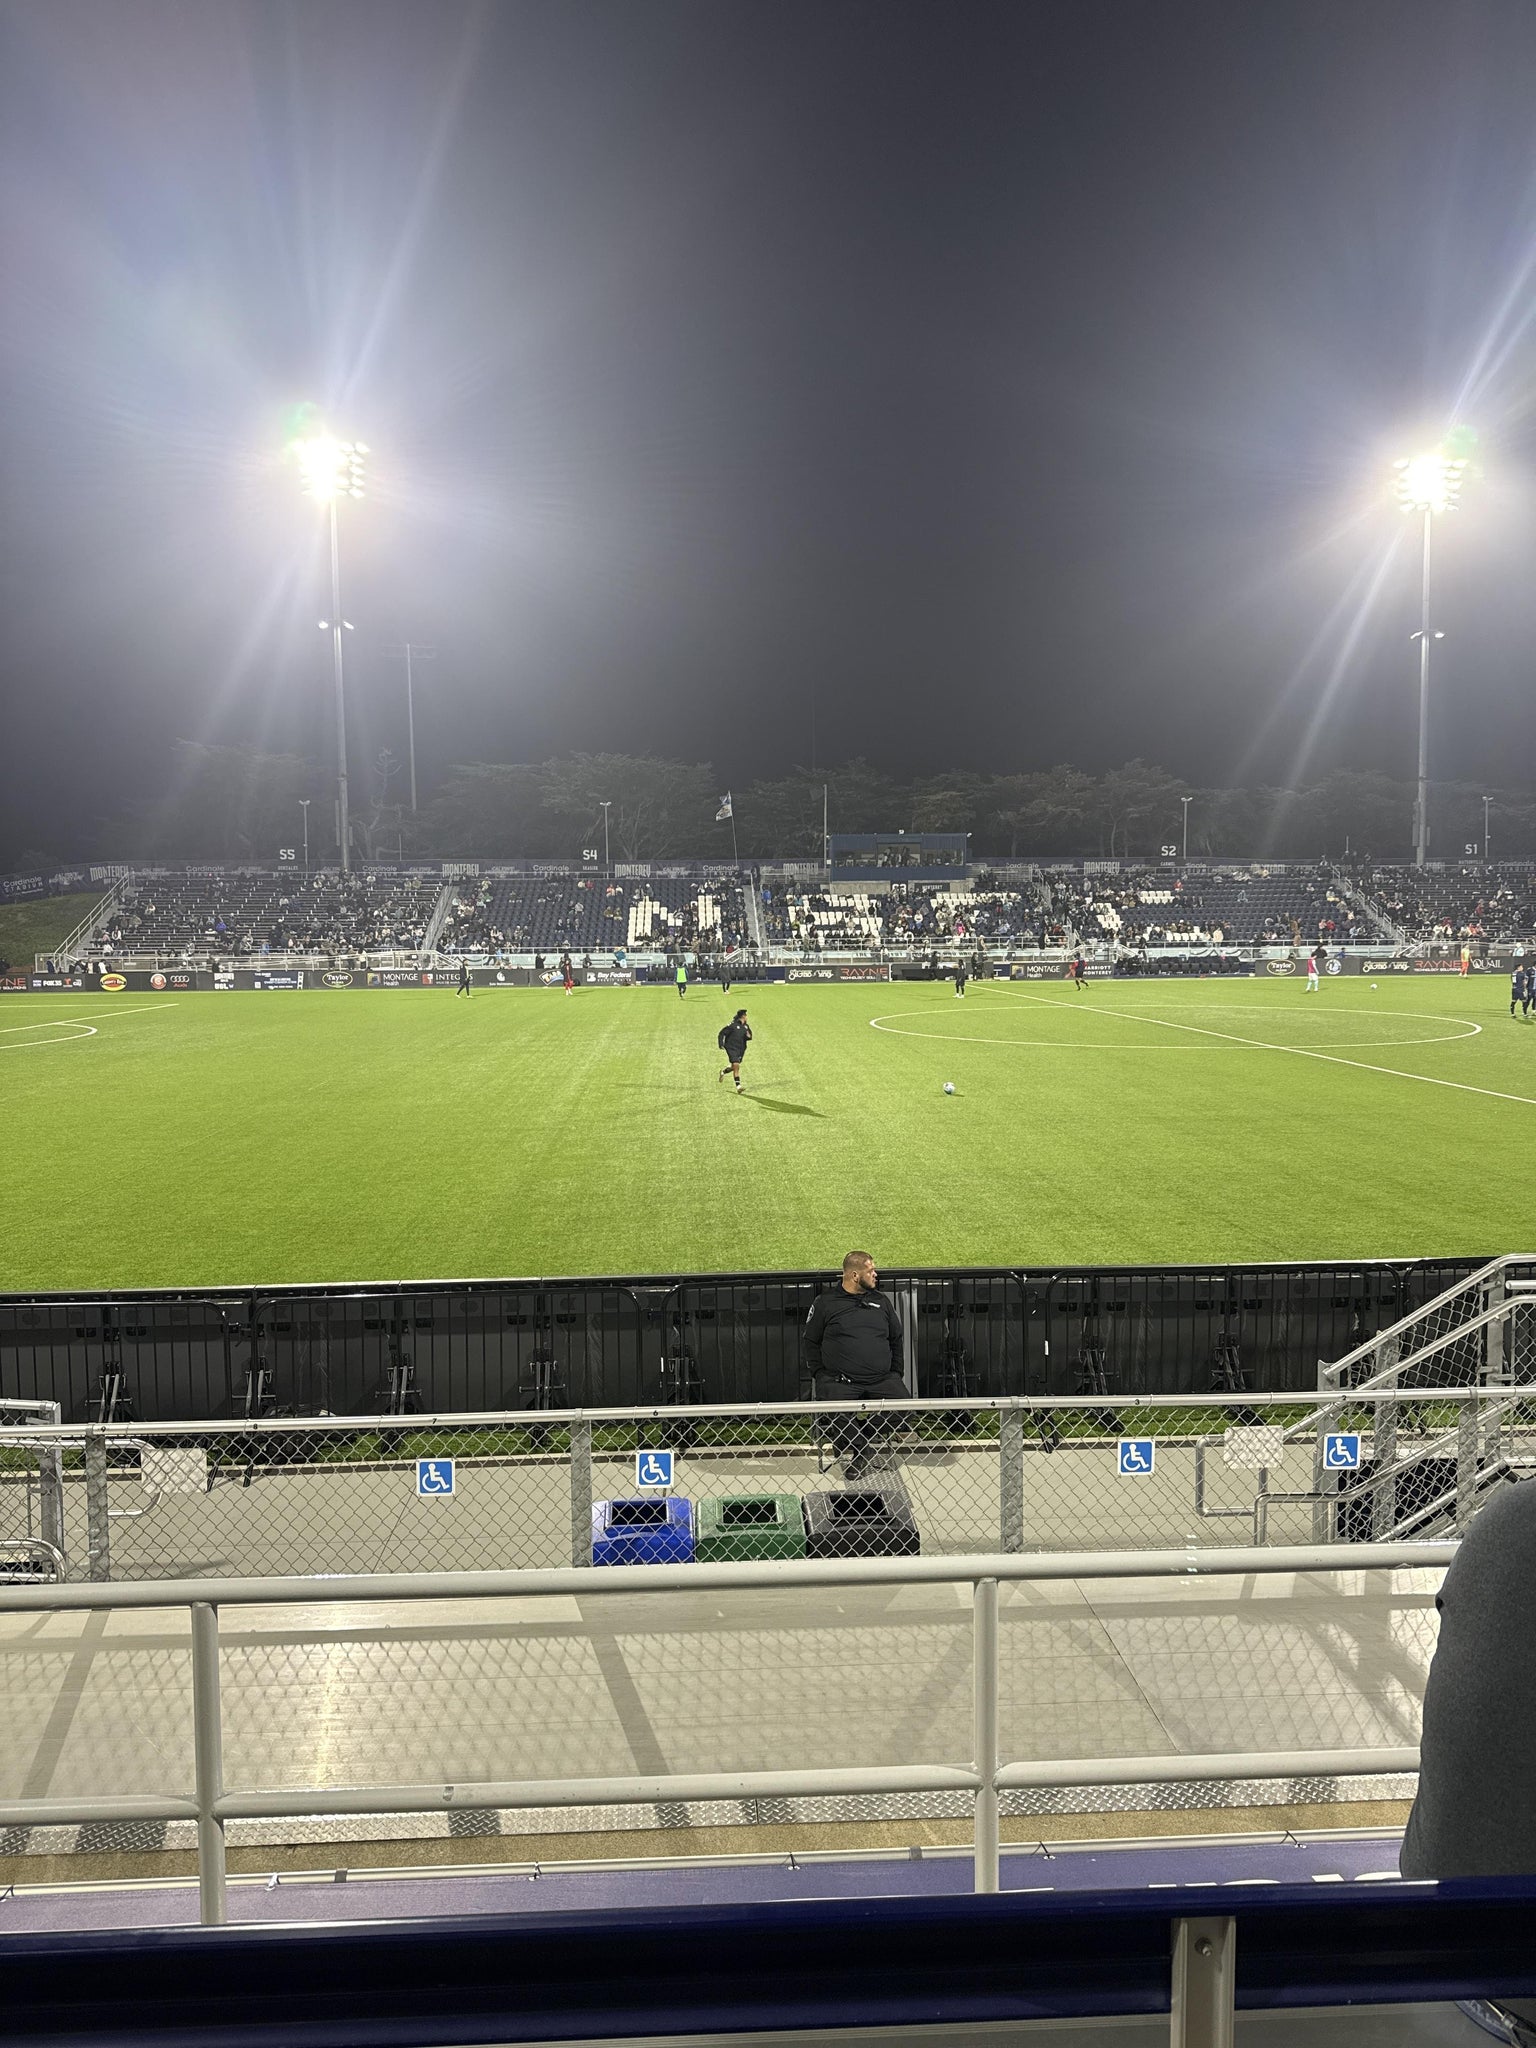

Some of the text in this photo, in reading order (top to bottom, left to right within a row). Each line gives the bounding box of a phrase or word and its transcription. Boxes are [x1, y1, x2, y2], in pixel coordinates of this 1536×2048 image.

[1161, 846, 1177, 856] S2
[1465, 844, 1478, 854] S1
[280, 849, 295, 860] S5
[583, 850, 598, 860] S4
[615, 864, 651, 877] MONTEREY
[1084, 862, 1120, 874] MONTEREY
[3, 876, 42, 887] Cardinale
[840, 968, 888, 976] RAYNE
